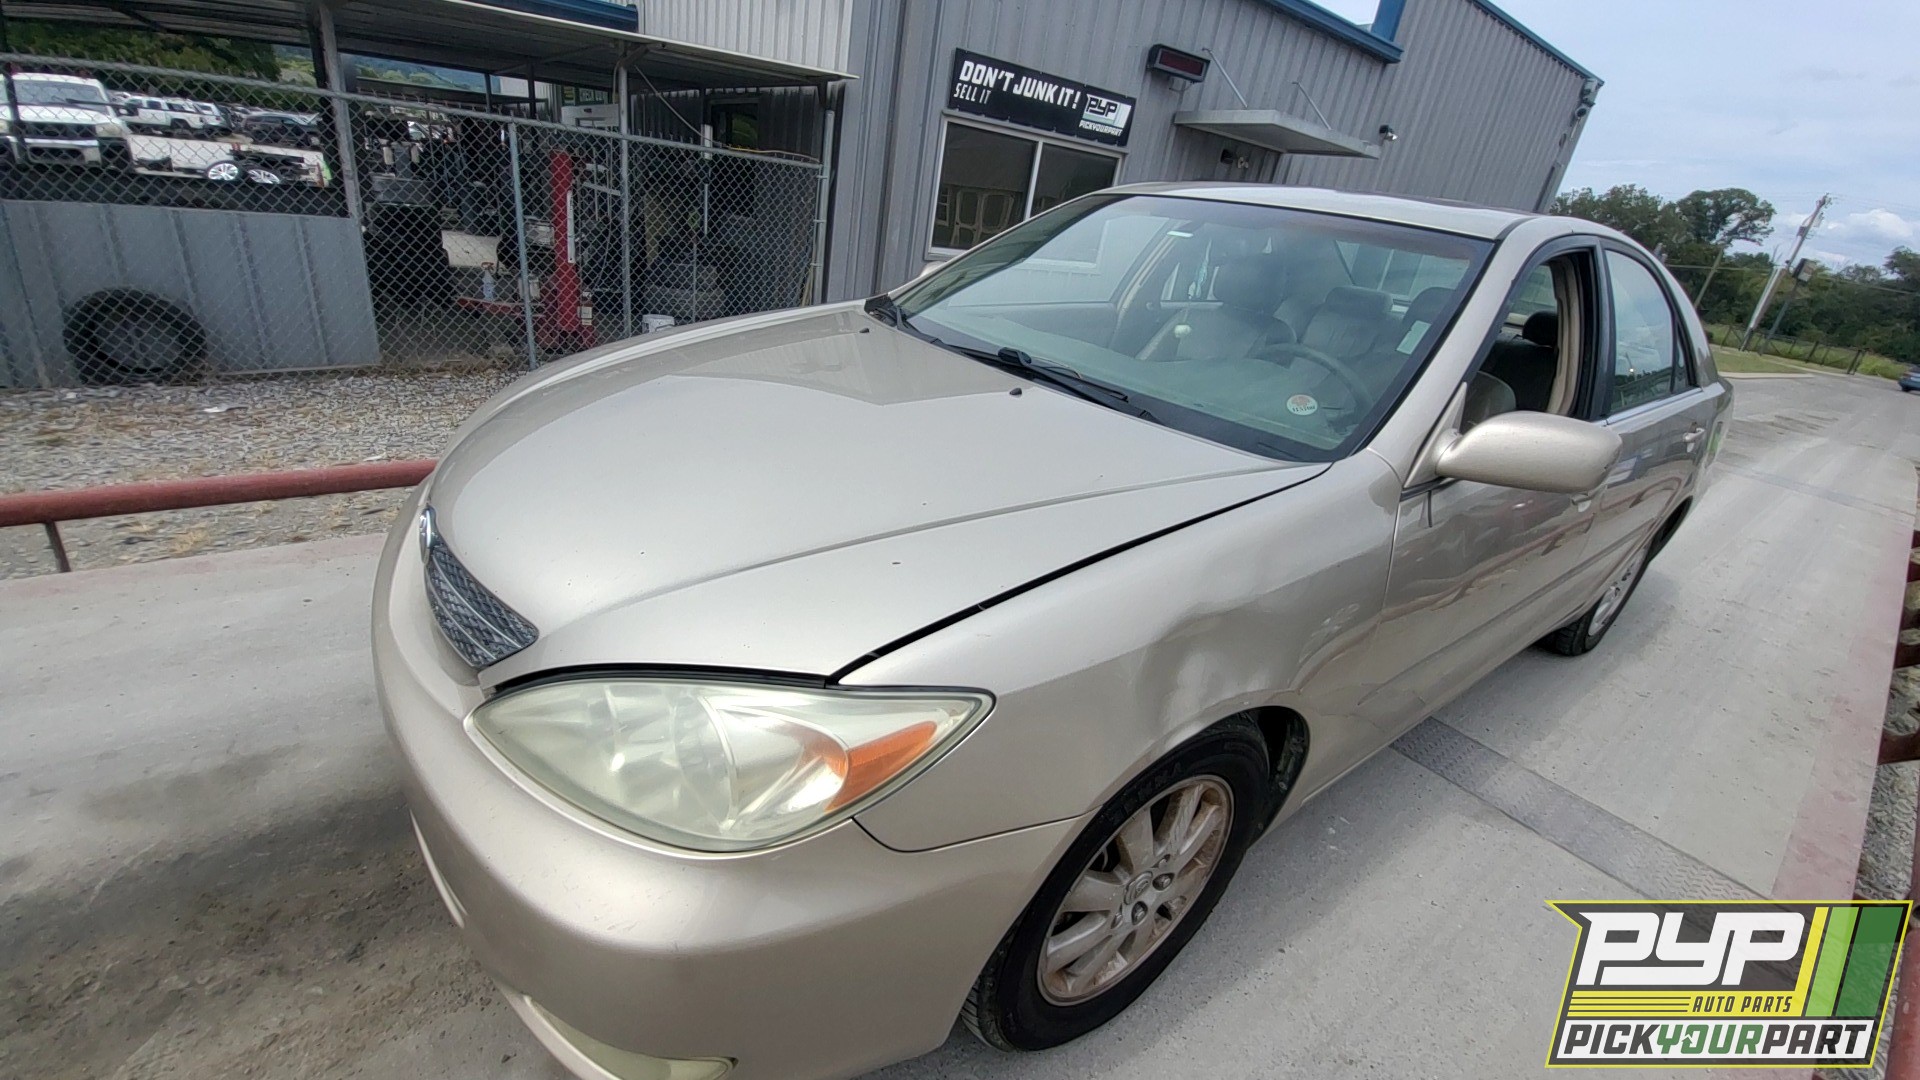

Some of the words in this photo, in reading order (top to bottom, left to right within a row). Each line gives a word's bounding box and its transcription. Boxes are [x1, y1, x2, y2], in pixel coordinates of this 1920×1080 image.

[953, 82, 977, 102] SELL
[979, 89, 992, 105] IT
[959, 60, 1014, 91] DON'T
[1013, 76, 1058, 105] JUNK
[1057, 87, 1081, 109] IT!
[1086, 95, 1118, 117] PYP
